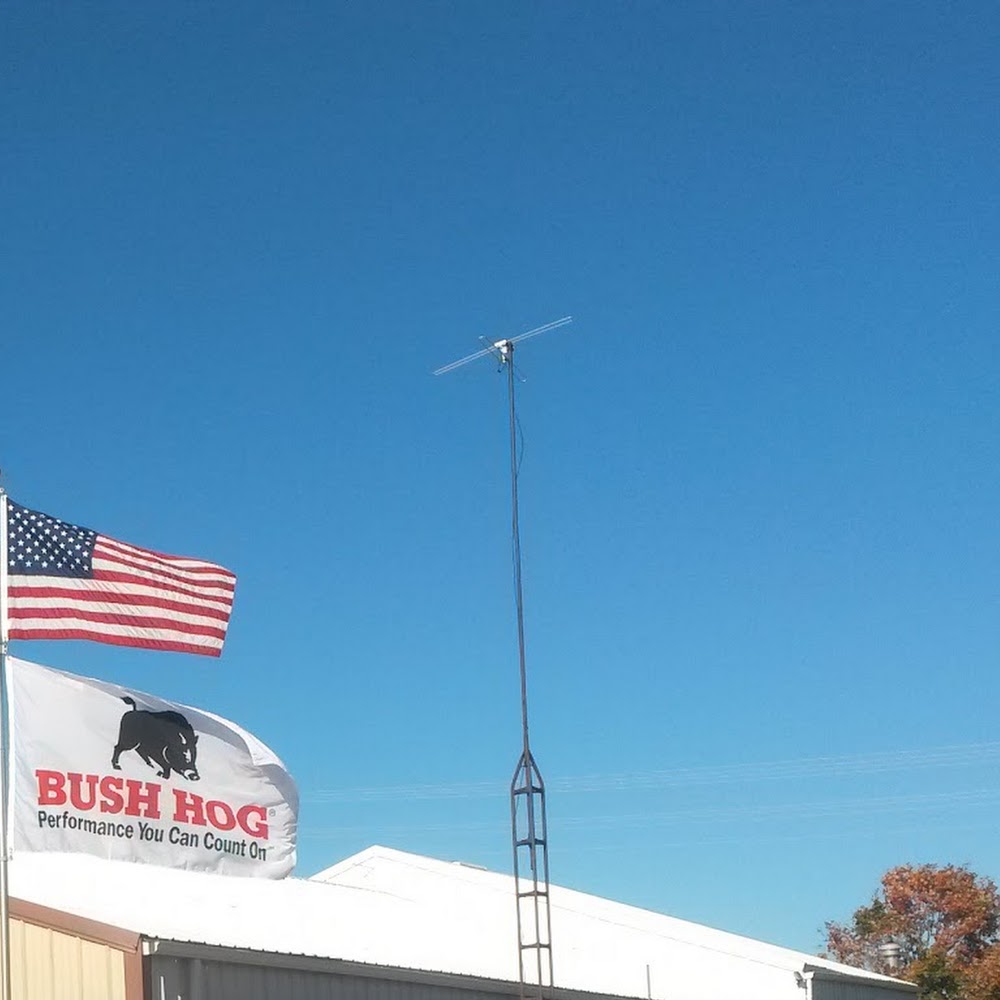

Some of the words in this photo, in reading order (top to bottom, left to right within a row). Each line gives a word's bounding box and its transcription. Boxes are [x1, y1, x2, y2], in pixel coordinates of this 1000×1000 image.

[35, 769, 161, 820] BUSH
[172, 788, 269, 840] HOG
[38, 811, 134, 840] Performance
[138, 822, 164, 843] You
[169, 827, 199, 847] Can
[203, 832, 247, 857] Count
[249, 841, 268, 862] On
